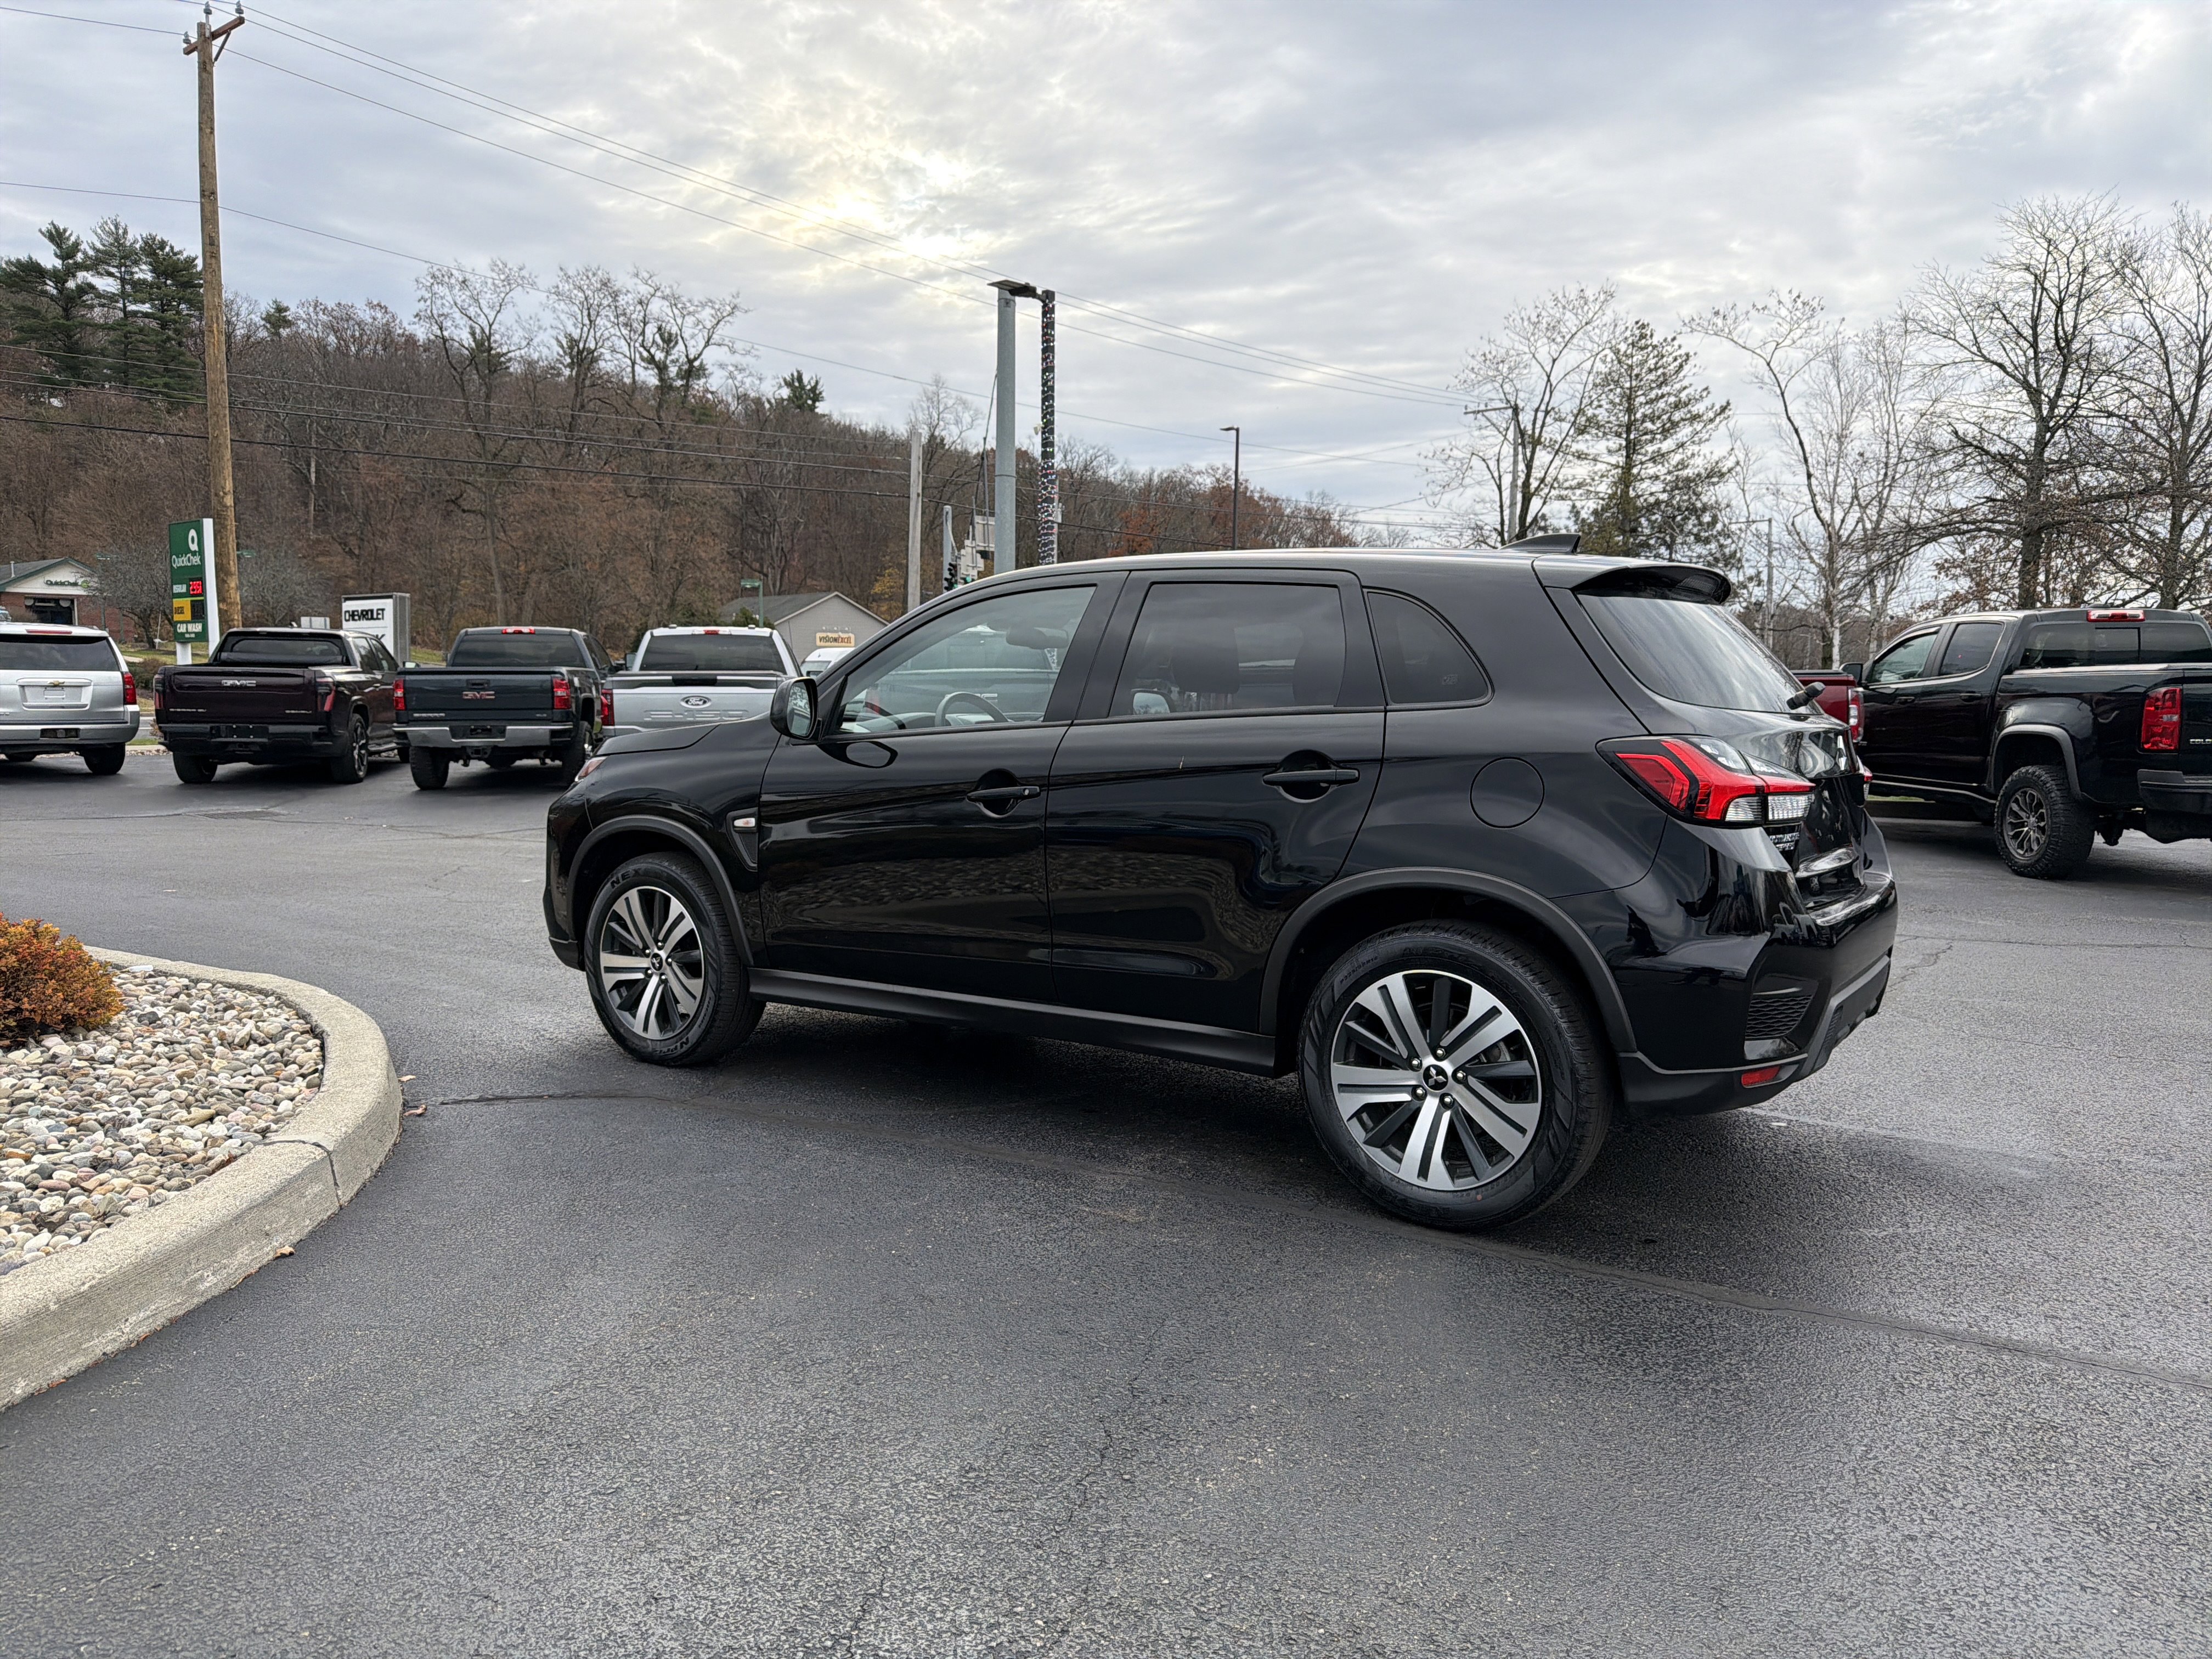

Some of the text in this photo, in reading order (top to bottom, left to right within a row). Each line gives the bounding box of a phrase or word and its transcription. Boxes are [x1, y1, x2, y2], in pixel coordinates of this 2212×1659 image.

[188, 528, 199, 551] Q
[172, 552, 201, 569] QuickChek
[344, 608, 386, 622] CHEVROLET
[177, 623, 202, 633] CAR WASH
[462, 691, 495, 699] GMC
